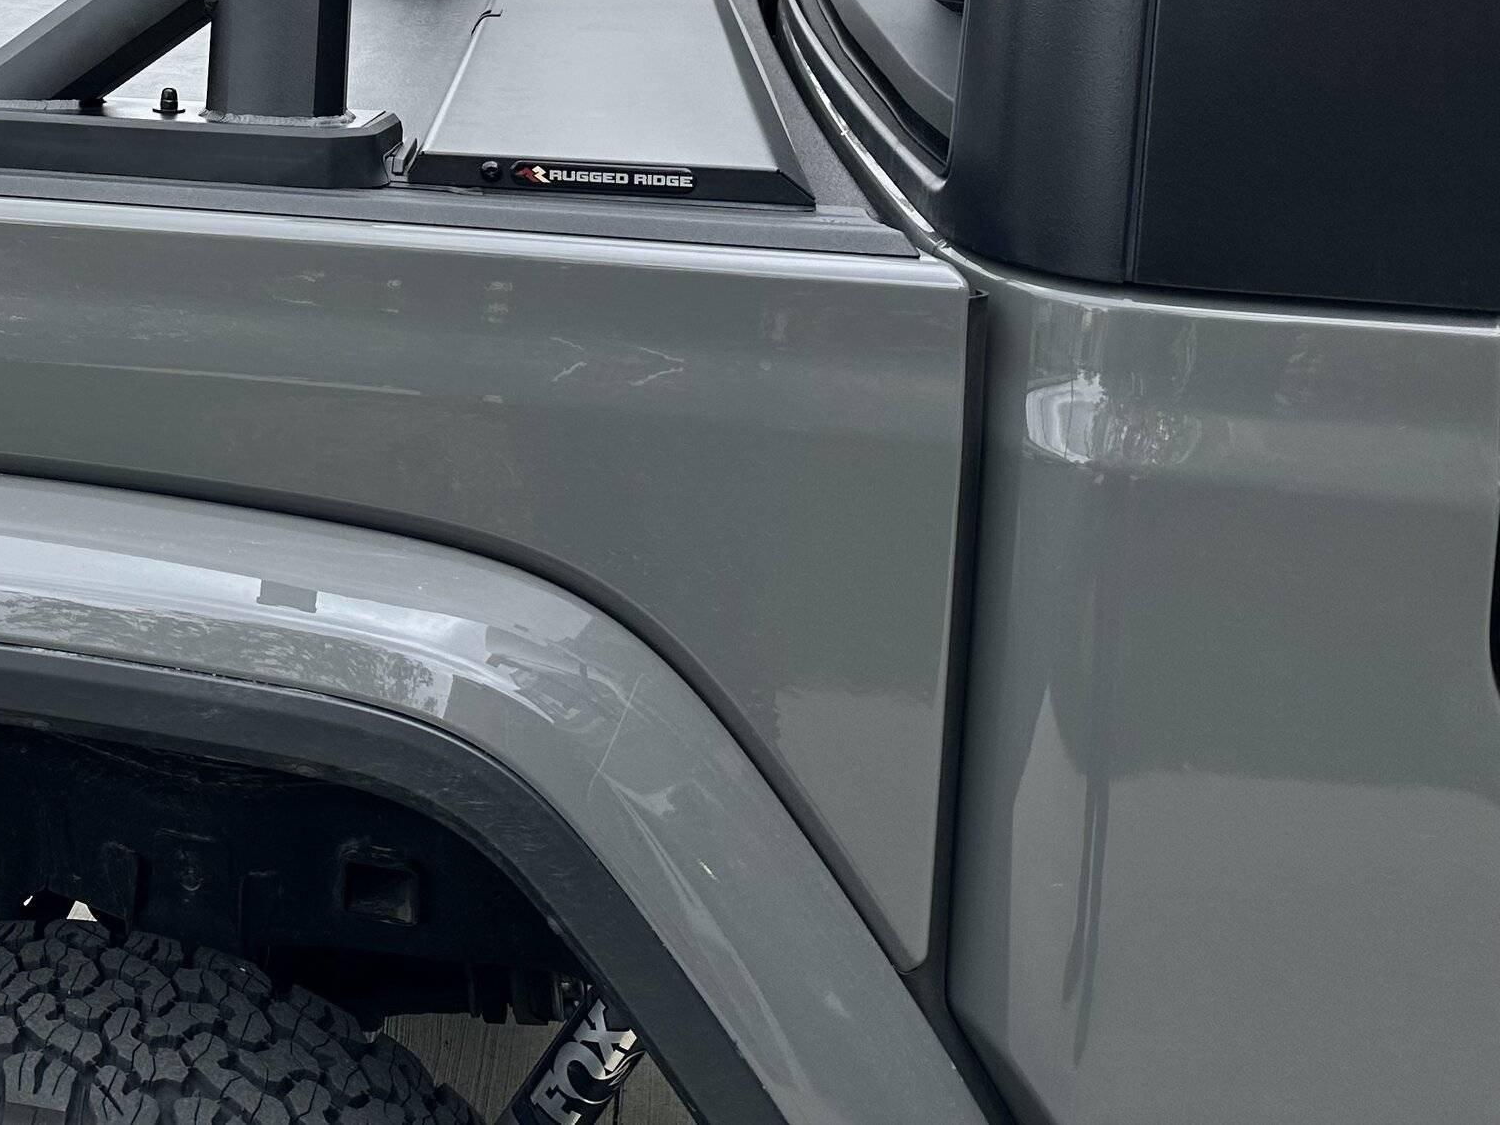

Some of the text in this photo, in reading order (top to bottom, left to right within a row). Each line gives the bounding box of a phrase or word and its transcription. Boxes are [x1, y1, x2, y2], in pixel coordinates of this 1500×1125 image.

[549, 169, 693, 188] RUGGED RIDGE
[531, 998, 637, 1125] FOX
